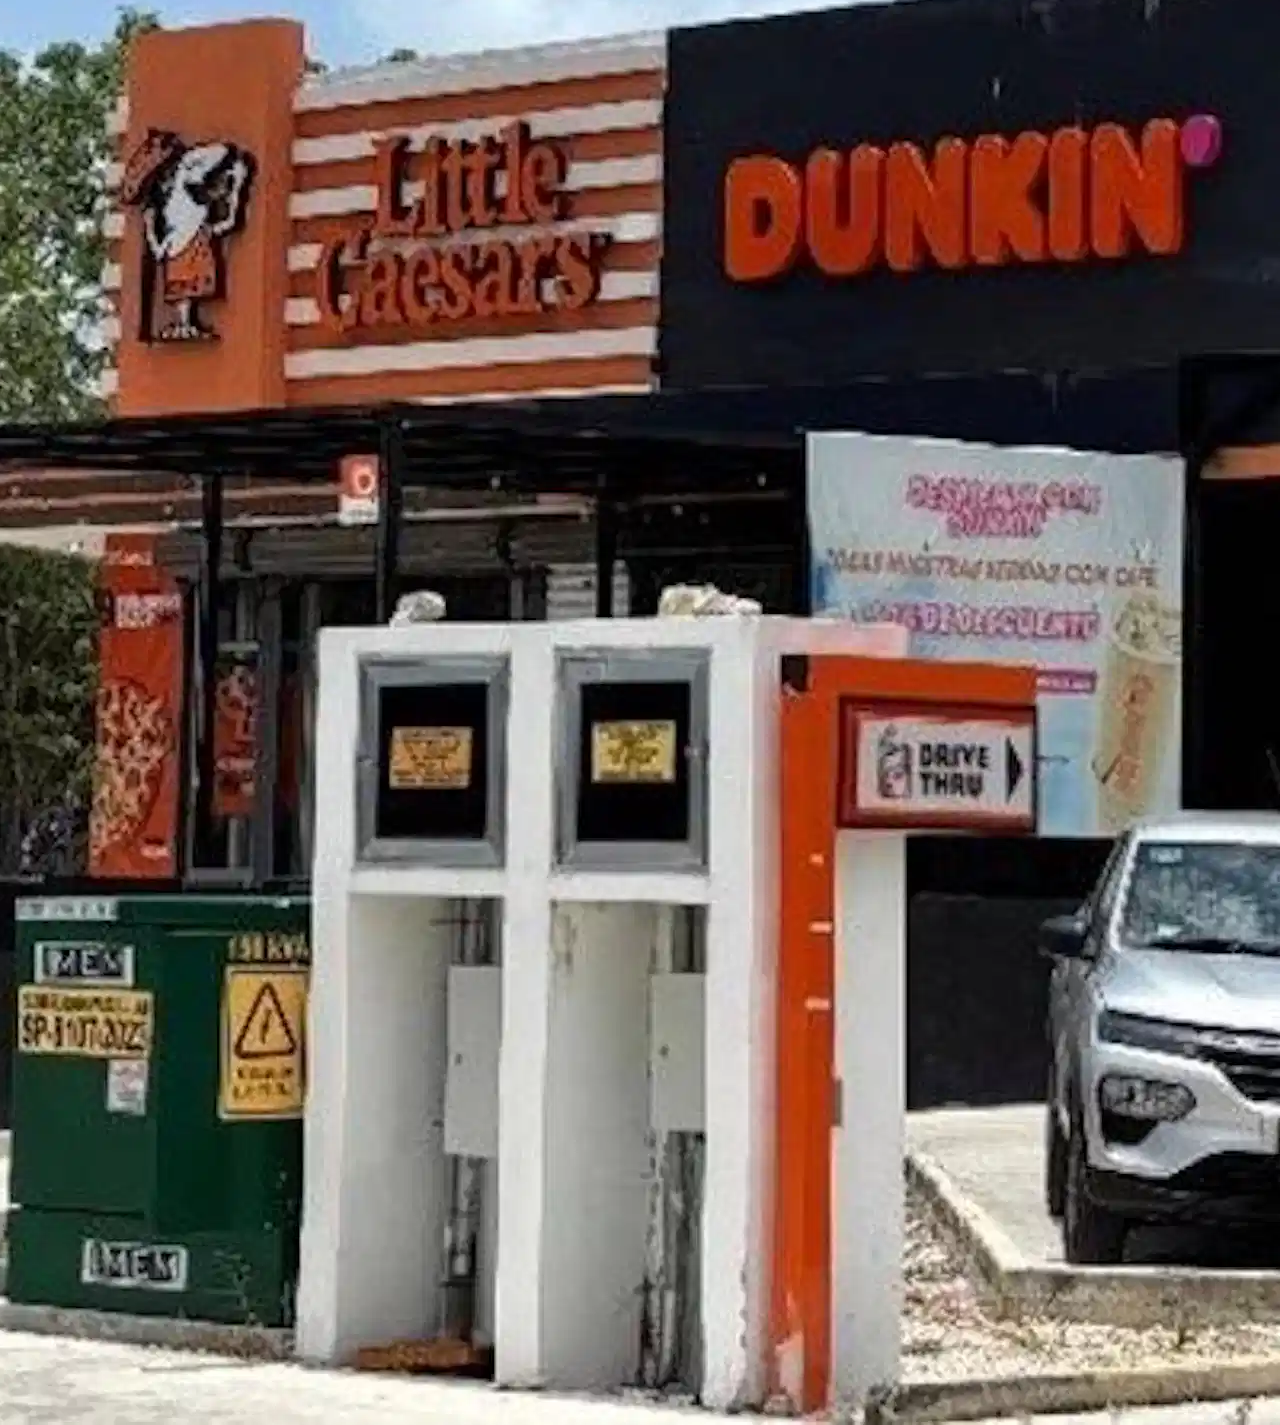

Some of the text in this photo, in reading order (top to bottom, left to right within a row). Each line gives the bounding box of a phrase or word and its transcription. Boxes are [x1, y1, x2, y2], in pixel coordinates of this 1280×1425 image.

[372, 120, 569, 236] Little
[919, 743, 991, 768] DRIVE
[919, 771, 985, 798] THRU
